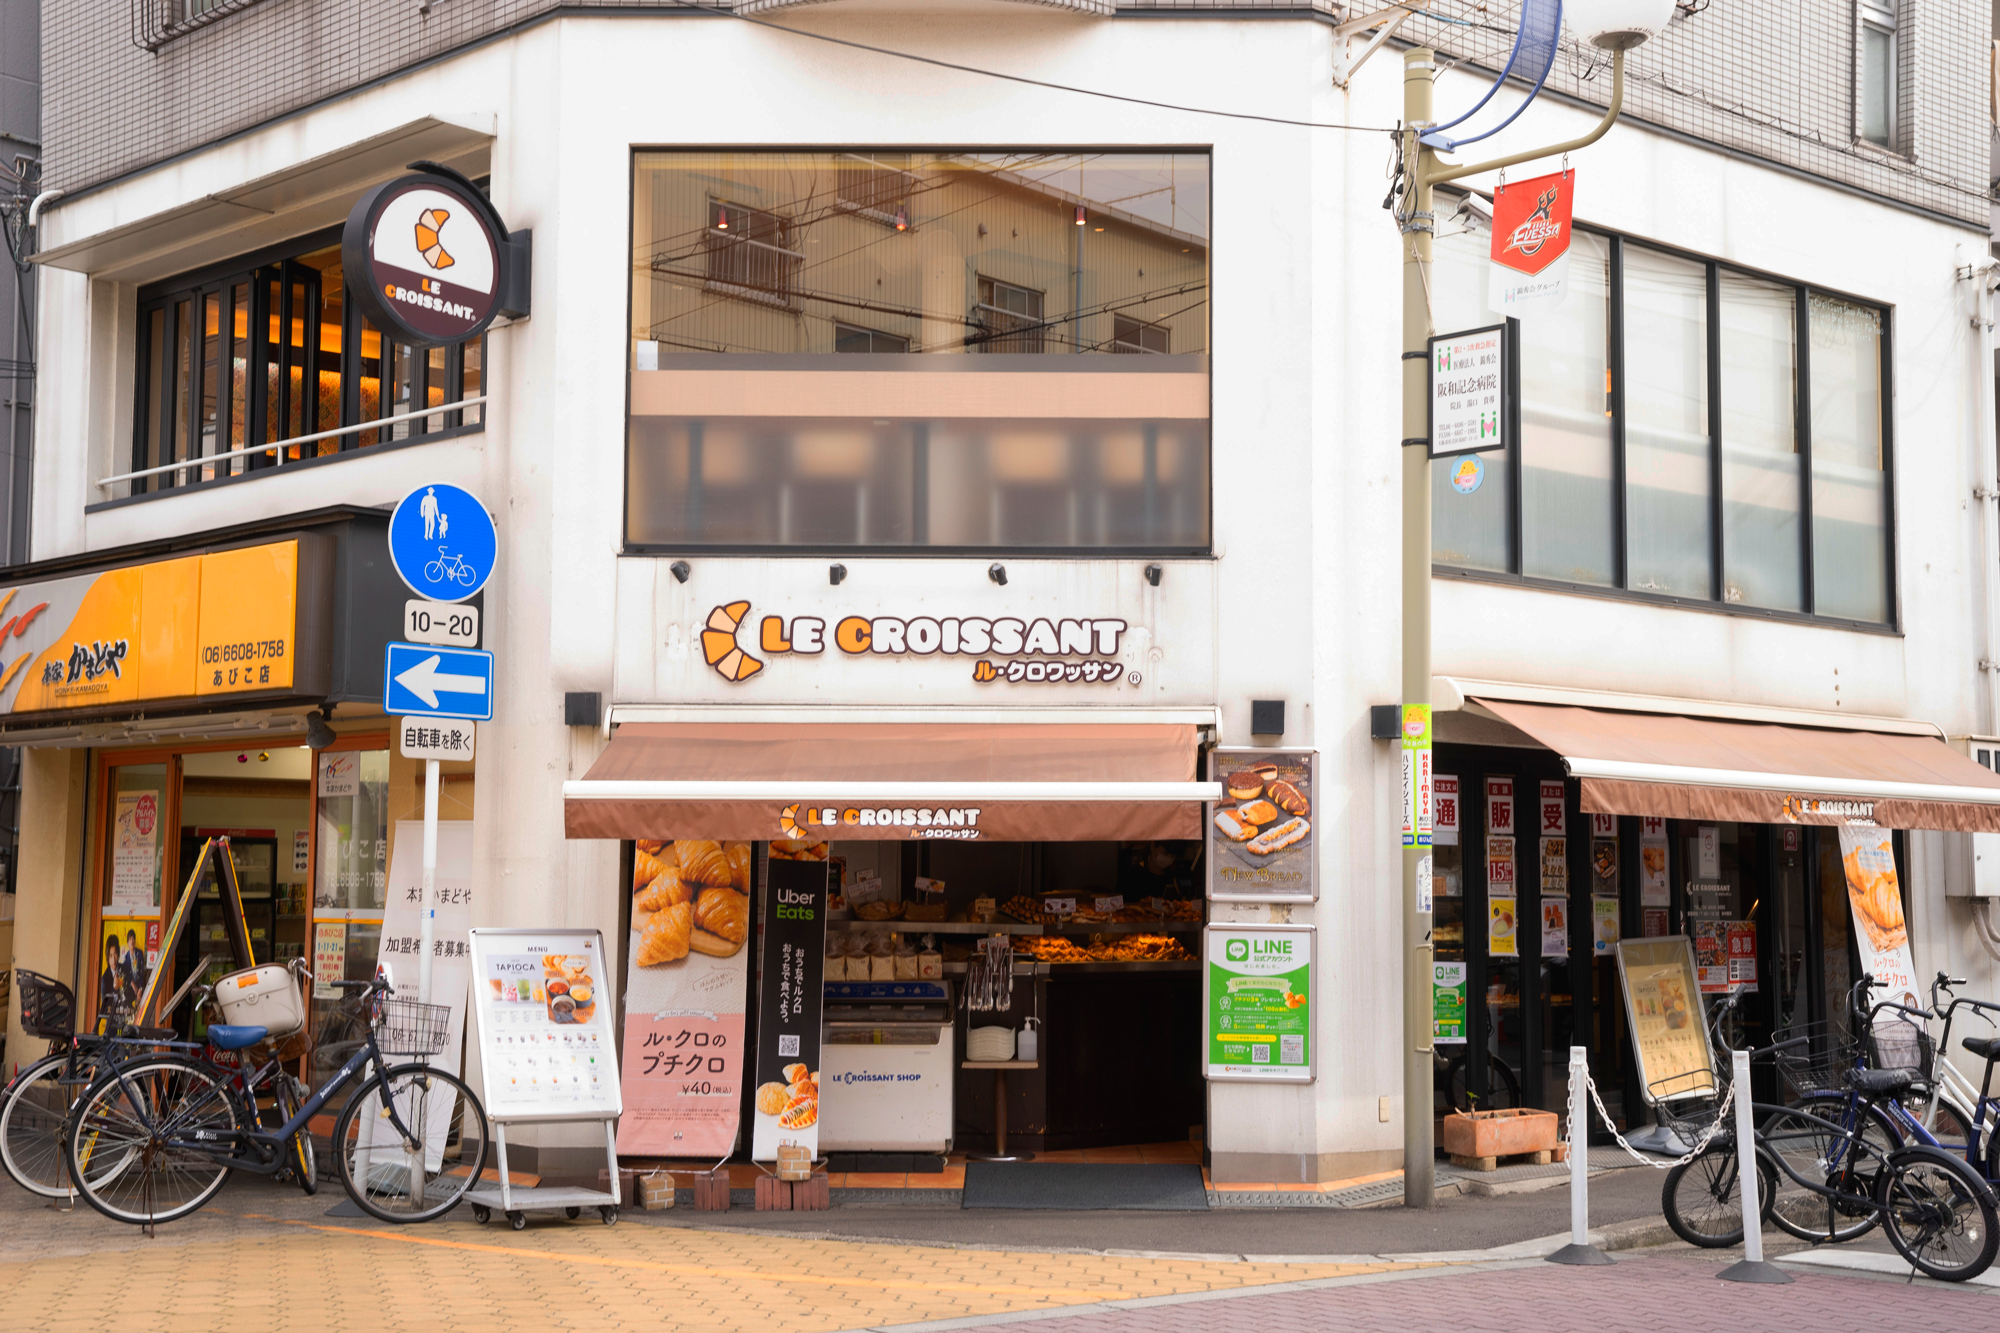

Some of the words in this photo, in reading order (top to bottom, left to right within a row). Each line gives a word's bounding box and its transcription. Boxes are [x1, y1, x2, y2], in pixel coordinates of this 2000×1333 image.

[421, 278, 441, 295] LE
[385, 284, 474, 320] CROISSANT
[1437, 373, 1497, 398] 阪和記念病院
[760, 615, 826, 655] LE
[834, 615, 1127, 657] CROISSANT
[201, 640, 285, 665] (06)6608-1758
[213, 666, 271, 686] あびこ店
[972, 660, 1124, 684] ル・クロワッサン
[54, 683, 109, 696] HONKE-KAMADOYA
[405, 727, 471, 751] 自転車を除く
[1421, 753, 1430, 815] HARIMAYA
[807, 808, 838, 826] LE
[843, 808, 981, 827] CROISSANT
[1436, 798, 1456, 827] 通
[1491, 801, 1511, 829] 販
[1543, 803, 1563, 831] 受
[1796, 799, 1810, 814] LE
[1811, 800, 1875, 817] CROISSANT
[1221, 867, 1255, 882] NEW
[1256, 867, 1303, 881] BREAD
[1491, 862, 1505, 881] 15
[778, 888, 815, 905] Uber
[776, 904, 815, 921] Eats
[1253, 939, 1293, 954] LINE
[495, 963, 536, 972] TAPIOCA
[1253, 955, 1294, 963] 公式アカウント
[1445, 966, 1460, 976] LINE
[643, 1029, 727, 1048] ル・クロの
[643, 1051, 725, 1075] プチクロ
[844, 1070, 894, 1084] CROISSANT
[682, 1081, 711, 1095] ¥40
[713, 1086, 732, 1095] (税込)
